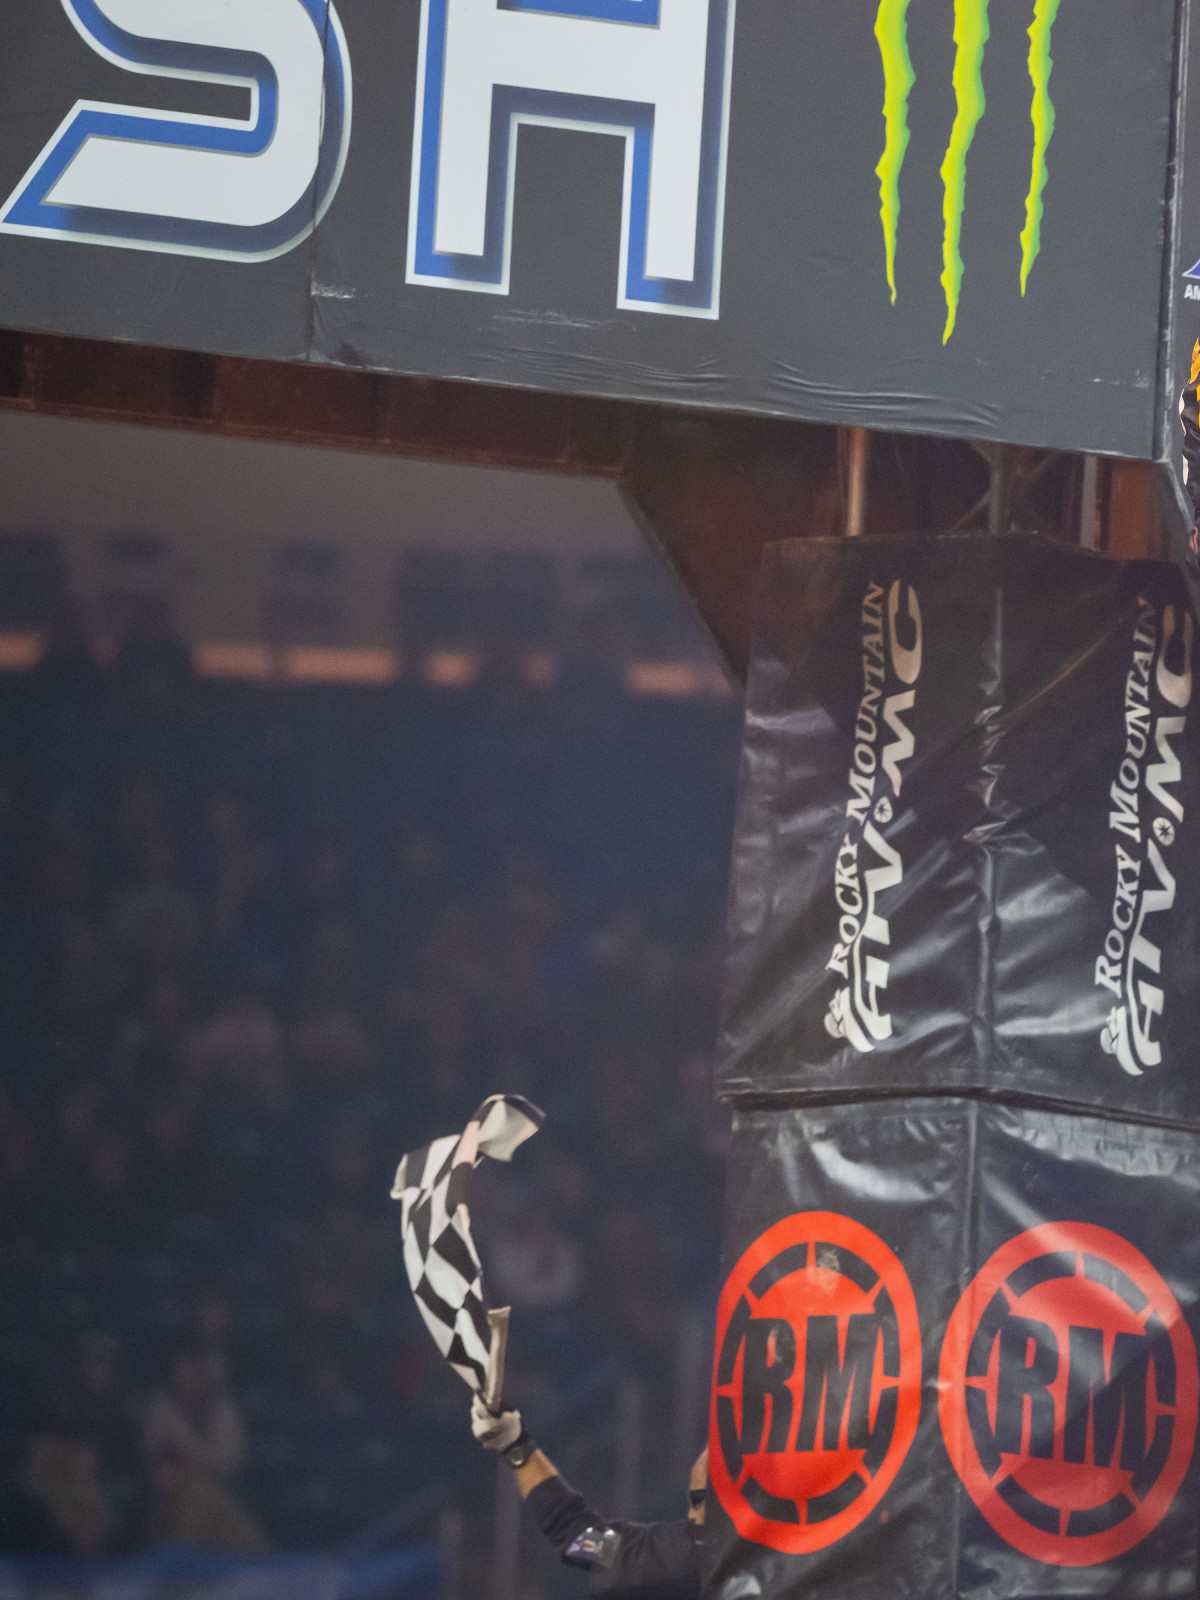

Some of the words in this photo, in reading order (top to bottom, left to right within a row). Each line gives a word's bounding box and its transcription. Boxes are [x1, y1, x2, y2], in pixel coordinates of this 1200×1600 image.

[826, 832, 864, 980] ROCKY
[845, 580, 886, 828] MOUNTAIN
[1108, 595, 1158, 843] MOUNTAIN
[1094, 844, 1142, 998] ROCKY
